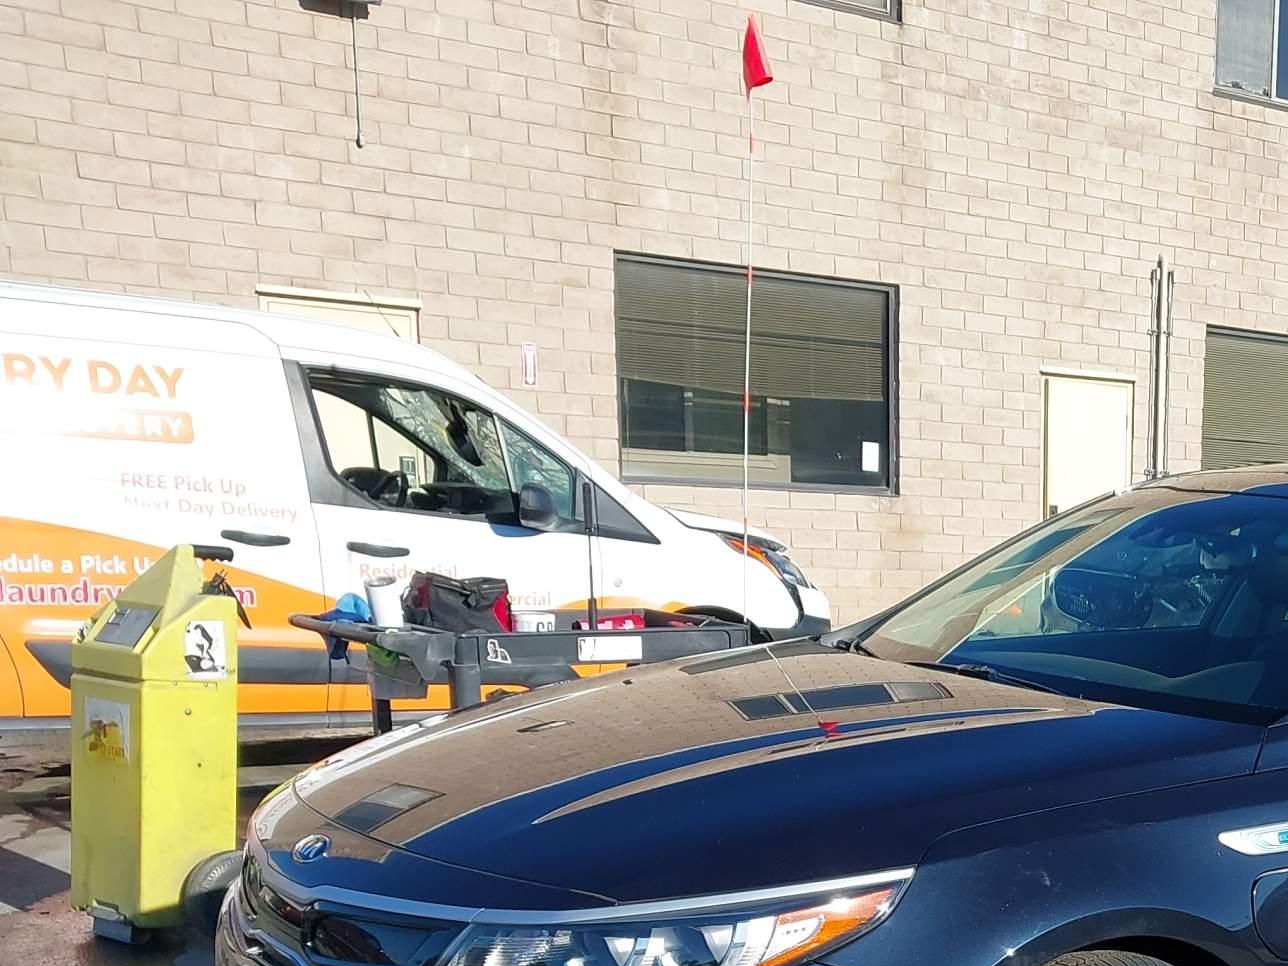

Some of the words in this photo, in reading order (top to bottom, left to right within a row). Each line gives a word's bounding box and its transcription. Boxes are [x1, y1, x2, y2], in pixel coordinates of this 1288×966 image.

[87, 360, 184, 399] DAY
[120, 472, 167, 490] FREE
[173, 475, 213, 492] Pick
[220, 480, 246, 496] Up
[178, 499, 215, 517] Day
[221, 501, 297, 522] Delivery
[0, 553, 53, 573] dule
[61, 559, 73, 574] a
[80, 554, 127, 574] Pick
[133, 556, 157, 576] U
[511, 592, 551, 606] ercial
